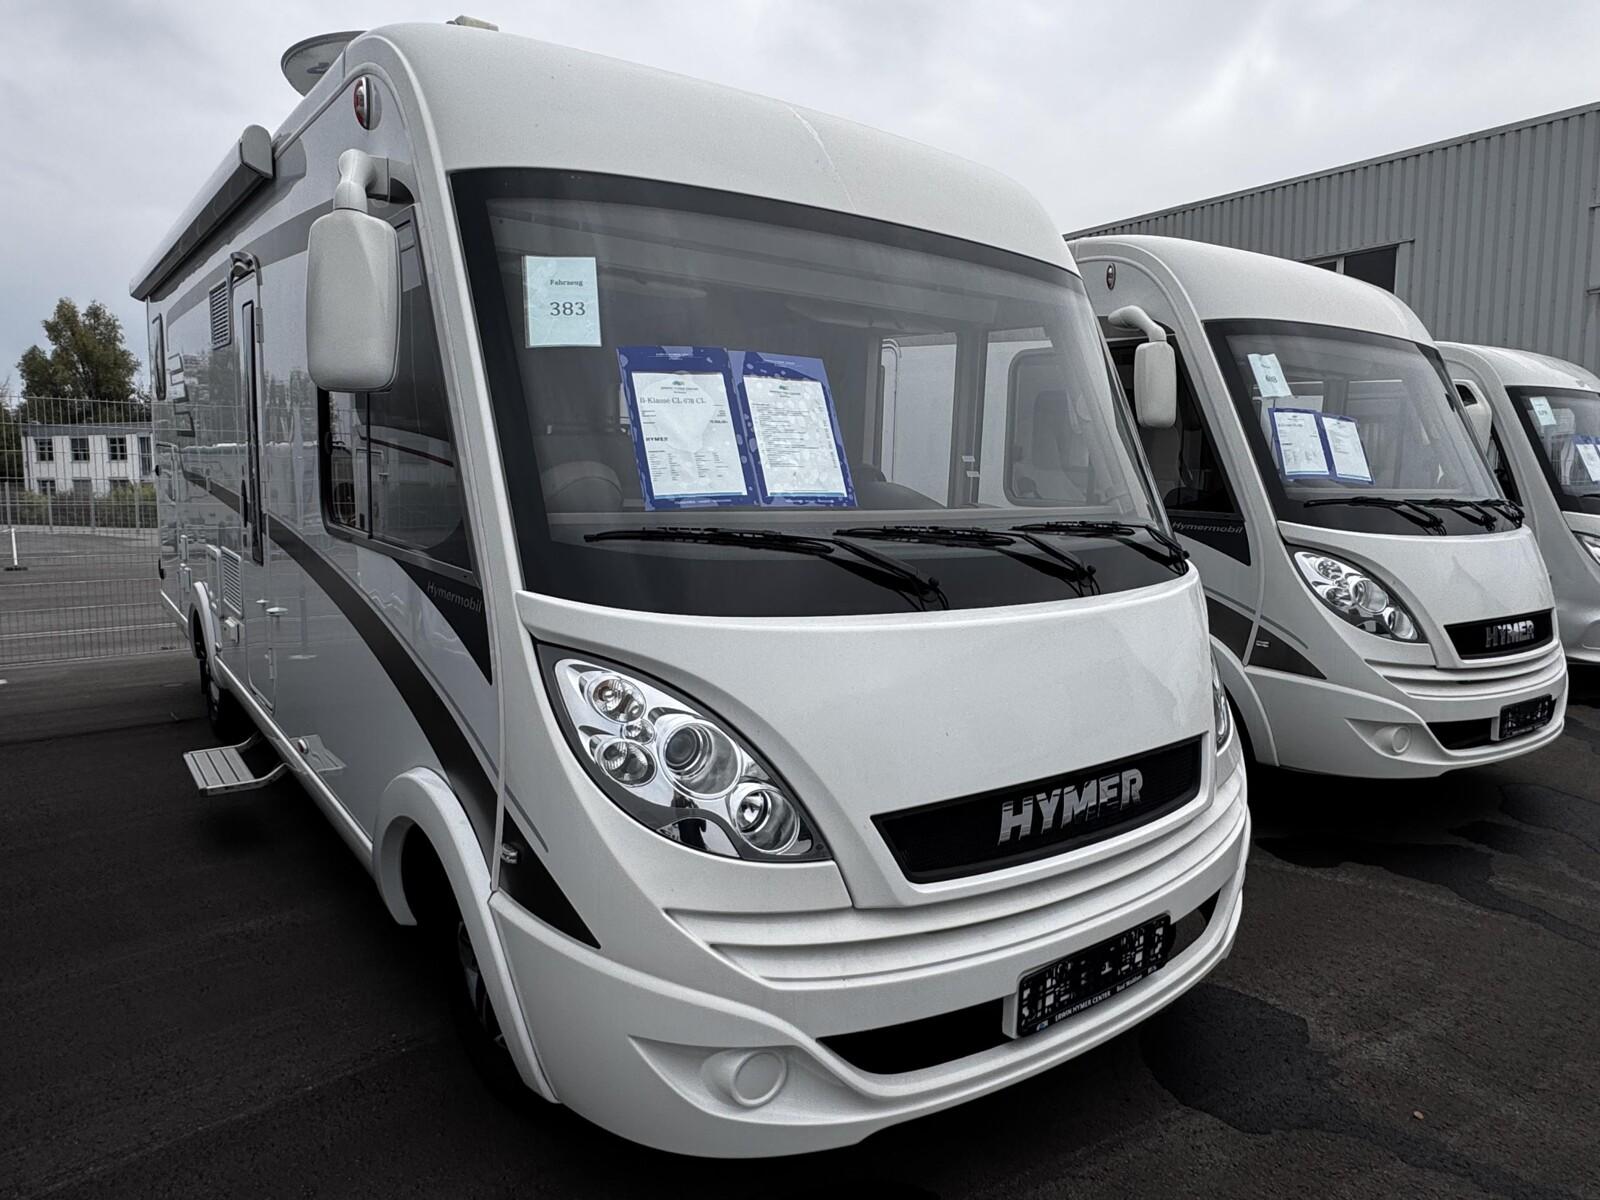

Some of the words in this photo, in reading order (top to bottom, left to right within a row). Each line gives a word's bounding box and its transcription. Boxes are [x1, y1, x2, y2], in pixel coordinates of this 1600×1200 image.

[550, 279, 584, 287] Fahrzeug
[550, 301, 586, 317] 383
[1172, 521, 1243, 534] Hymermobil
[427, 580, 482, 613] Hymermobil
[1485, 620, 1534, 648] HYMER
[997, 768, 1143, 846] HYMER
[1092, 990, 1112, 1005] CENTER
